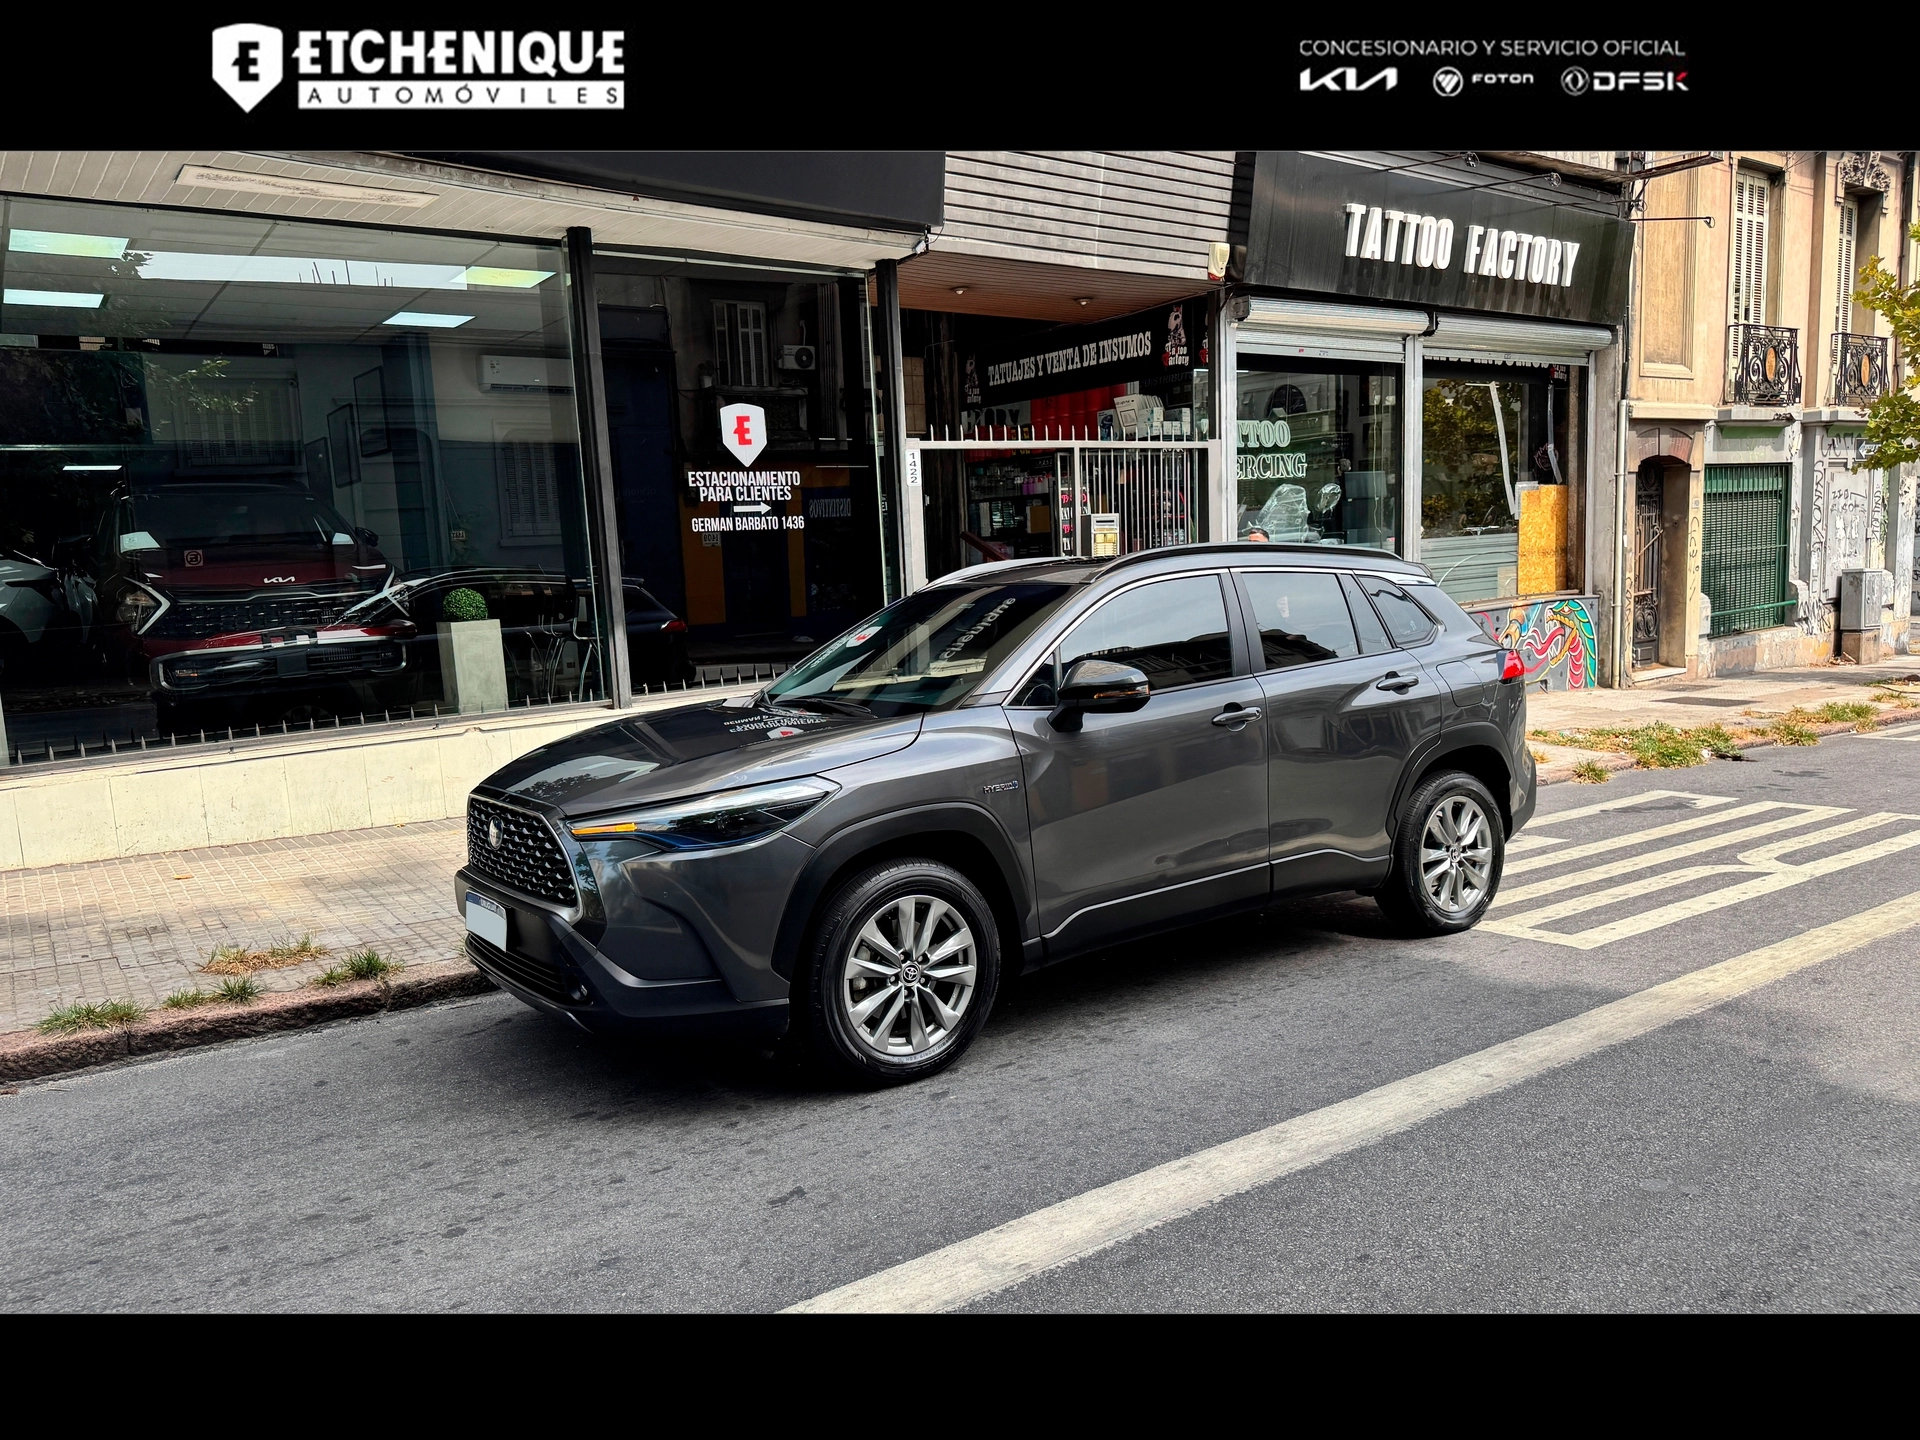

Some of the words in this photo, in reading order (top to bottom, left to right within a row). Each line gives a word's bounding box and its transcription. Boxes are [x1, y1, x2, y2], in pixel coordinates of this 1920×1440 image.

[1345, 203, 1454, 270] TATTOO
[1463, 225, 1580, 287] FACTORY
[988, 357, 1035, 386] TATUAJES
[1037, 355, 1045, 377] Y
[1044, 346, 1082, 374] VENTA
[1082, 342, 1097, 366] DE
[1099, 331, 1151, 364] INSUMOS
[733, 415, 752, 445] E
[688, 471, 801, 487] ESTACIONAMIENTO
[909, 452, 918, 483] 1422
[700, 486, 733, 502] PARA
[735, 485, 792, 501] CLIENTES
[692, 518, 733, 532] GERMAN
[735, 516, 779, 531] BARBATO
[781, 516, 805, 530] 1436
[983, 780, 1019, 793] HYBRID
